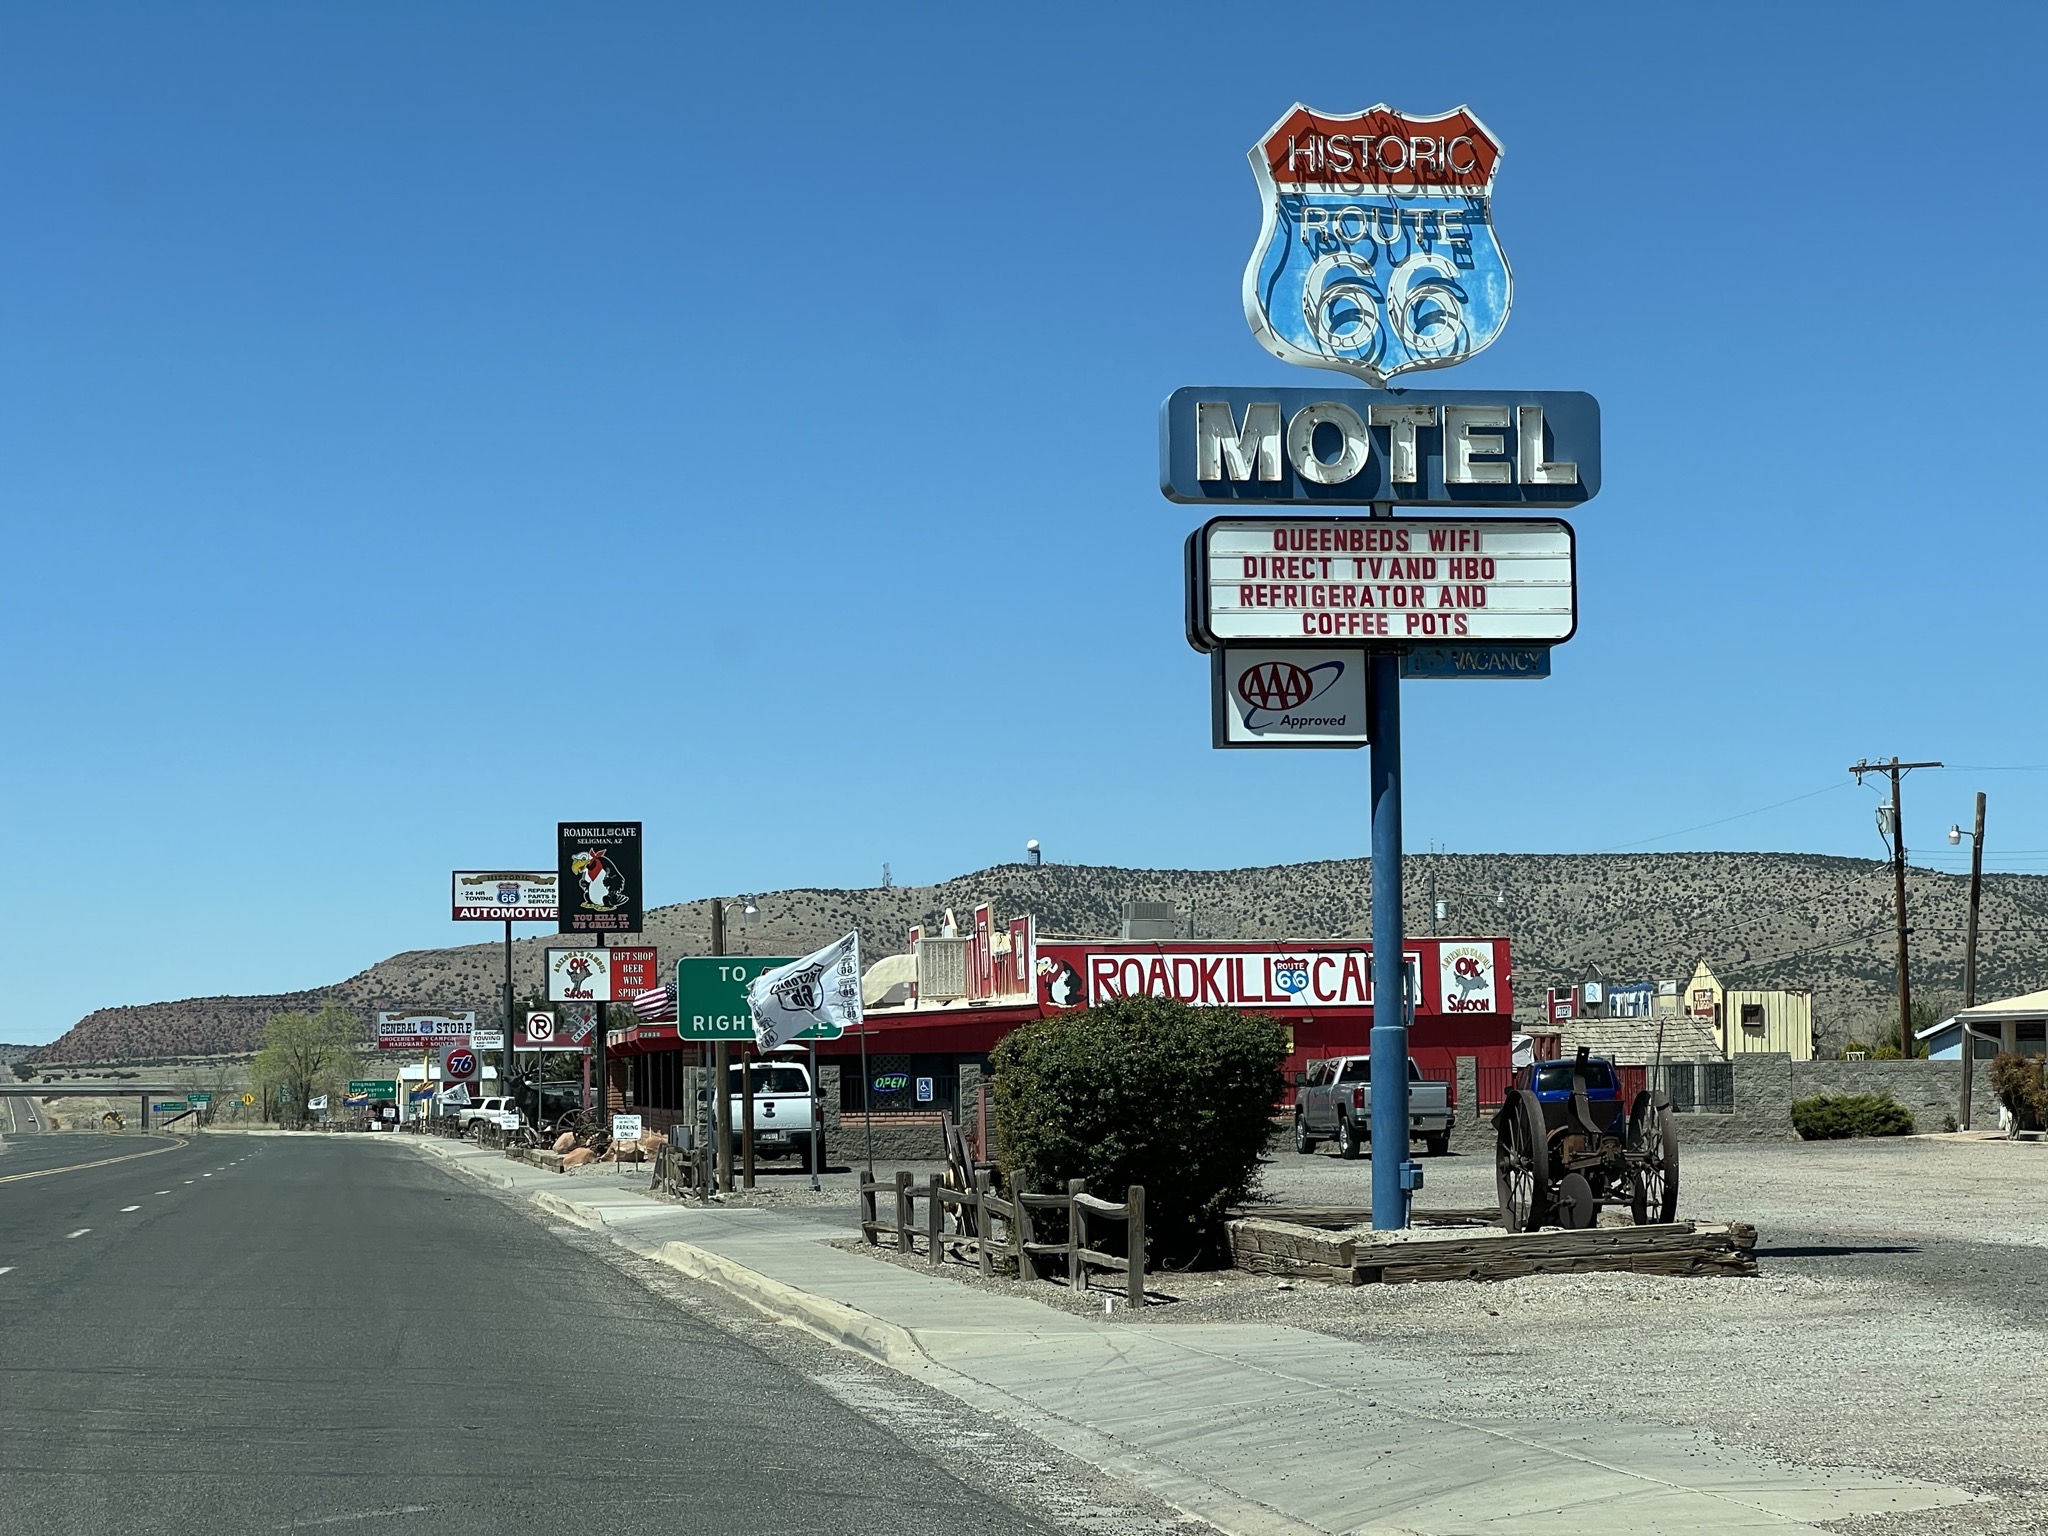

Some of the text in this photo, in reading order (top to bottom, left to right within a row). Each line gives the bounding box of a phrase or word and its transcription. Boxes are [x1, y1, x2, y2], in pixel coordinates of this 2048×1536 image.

[1288, 135, 1477, 174] HISTORIC
[1301, 206, 1467, 246] ROUTE
[1303, 253, 1465, 351] 66
[1196, 401, 1578, 485] MOTEL
[1428, 530, 1480, 552] WIFI
[1244, 556, 1332, 579] DIRECT
[1449, 558, 1495, 580] HBO
[1240, 585, 1486, 608] REFRIGERATOR AND
[1302, 613, 1468, 635] COFFEE POTS
[1454, 652, 1541, 670] VACANCY
[1243, 663, 1308, 709] AAA
[1280, 715, 1346, 729] Approved
[564, 828, 607, 837] ROADKILL
[615, 828, 636, 837] CAFE
[501, 893, 516, 903] 66
[460, 907, 558, 918] AUTOMOTIVE
[570, 958, 588, 971] OK
[613, 951, 654, 960] GIFT SHOP
[623, 964, 644, 973] BEER
[719, 966, 747, 981] TO
[1277, 962, 1305, 970] ROUTE
[1455, 957, 1479, 977] OK
[623, 976, 644, 985] WINE
[1092, 957, 1292, 1002] ROADKILL
[1276, 970, 1307, 989] 66
[380, 1023, 418, 1034] GENERAL
[436, 1022, 473, 1034] STORE
[451, 1055, 472, 1073] 76
[875, 1077, 907, 1088] OPEN
